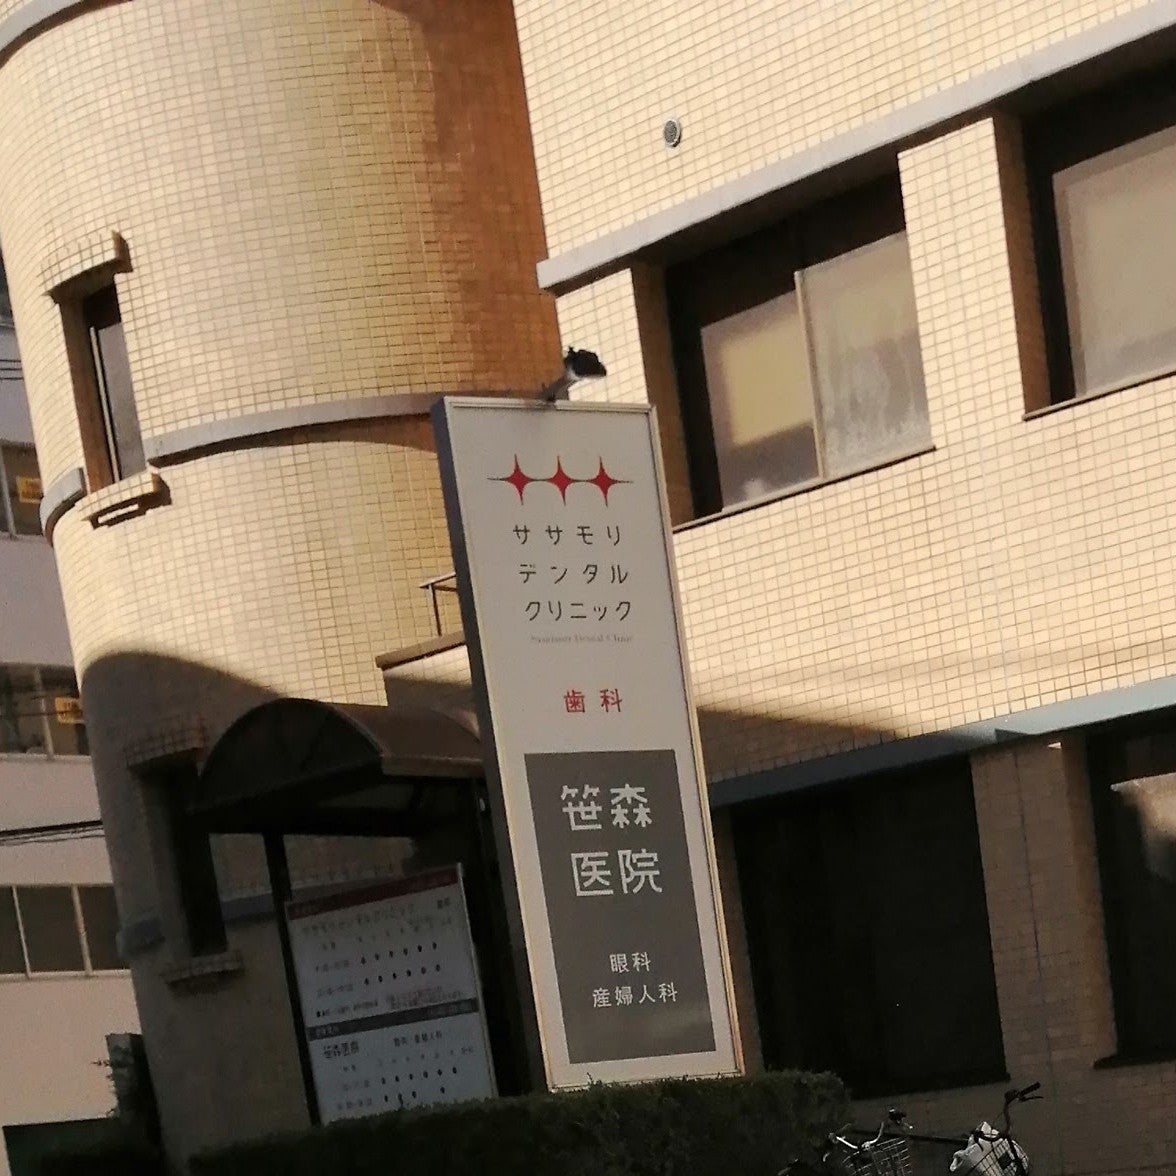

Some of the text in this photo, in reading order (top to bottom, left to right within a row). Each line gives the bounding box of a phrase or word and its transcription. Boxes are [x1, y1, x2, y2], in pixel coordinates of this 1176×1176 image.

[512, 525, 620, 546] ササモリ
[518, 563, 629, 584] デンタル
[524, 600, 631, 621] クリニック
[563, 688, 623, 713] 歯科
[560, 783, 652, 831] 笹森
[570, 848, 663, 897] 医院
[609, 951, 651, 973] 眼科
[592, 982, 678, 1008] 産婦人科
